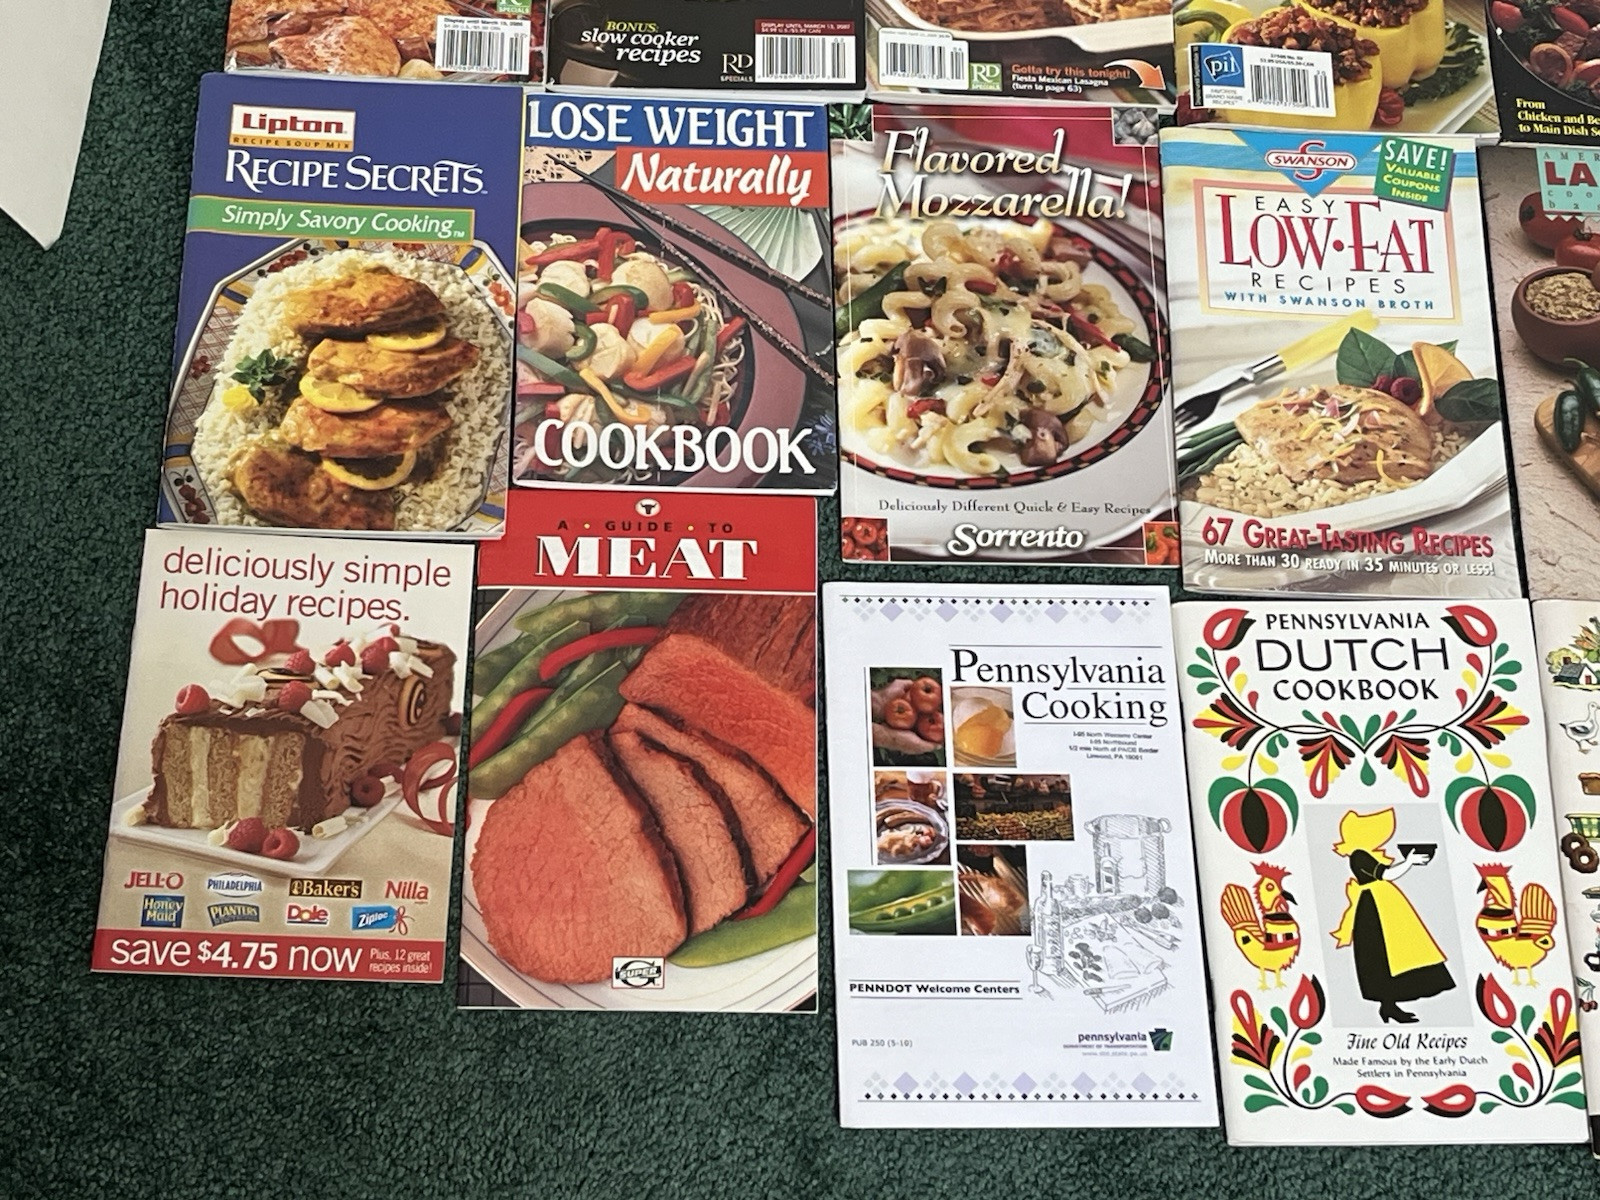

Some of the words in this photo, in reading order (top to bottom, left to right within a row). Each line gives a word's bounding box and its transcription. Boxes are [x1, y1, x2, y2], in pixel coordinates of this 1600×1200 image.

[606, 21, 659, 32] BONUS:
[581, 28, 627, 44] slow
[630, 31, 699, 48] cooker
[616, 47, 701, 66] recipes
[722, 53, 754, 74] RD
[1210, 56, 1236, 76] pil
[972, 63, 1000, 83] RD
[1012, 64, 1043, 74] Gotta
[1045, 65, 1062, 78] try
[1064, 67, 1085, 77] this
[1088, 67, 1131, 80] tonight!
[1012, 74, 1036, 83] Fiesta
[1038, 76, 1072, 84] Mexican
[1074, 77, 1109, 87] Lasagna
[1012, 82, 1033, 91] (turn
[1034, 83, 1043, 91] to
[1045, 84, 1065, 93] page
[1067, 84, 1082, 93] 63)
[1515, 98, 1546, 110] From
[242, 112, 344, 135] Lipton
[528, 100, 633, 143] LOSE
[643, 106, 815, 148] WEIGHT
[1517, 110, 1561, 123] Chicken
[1563, 114, 1584, 125] and
[1519, 124, 1531, 133] to
[1533, 123, 1561, 135] Main
[1563, 125, 1589, 136] Dish
[233, 137, 280, 146] RECIPE
[286, 140, 321, 148] SOUP
[878, 125, 1066, 175] Flavored
[1272, 154, 1349, 167] SWANSON
[1384, 139, 1448, 171] SAVE!
[225, 149, 340, 193] RECIPE
[345, 155, 484, 197] SECRETS
[620, 152, 813, 207] Naturally
[1385, 162, 1441, 182] VALUABLE
[873, 167, 1133, 219] Mozzarella!
[1383, 174, 1440, 194] COUPONS
[1391, 186, 1428, 203] INSIDE
[1255, 195, 1335, 215] EASY
[222, 205, 293, 230] Simply
[297, 209, 367, 234] Savory
[1252, 272, 1406, 294] RECIPES
[1224, 291, 1267, 303] WITH
[1279, 294, 1366, 308] SWANSON
[1378, 299, 1434, 310] BROTH
[534, 418, 816, 475] COOKBOOK
[878, 499, 948, 514] Deliciously
[952, 500, 1009, 513] Different
[1013, 501, 1054, 515] Quick
[1057, 502, 1067, 513] &
[1071, 502, 1100, 516] Easy
[1103, 503, 1152, 516] Recipes
[557, 520, 569, 530] A
[604, 520, 673, 533] GUIDE
[708, 522, 734, 533] TO
[947, 523, 1084, 557] Sorrento
[1201, 516, 1233, 546] 67
[1411, 526, 1495, 557] RECIPES
[535, 535, 758, 580] MEAT
[1204, 549, 1241, 566] MORE
[1245, 553, 1276, 568] THAN
[1280, 553, 1300, 568] 30
[1305, 558, 1342, 571] READY
[1346, 558, 1361, 572] IN
[1364, 557, 1384, 572] 35
[1389, 560, 1439, 574] MINUTES
[1442, 562, 1460, 575] OR
[1464, 562, 1495, 576] LESS!
[163, 546, 336, 588] deliciously
[343, 555, 451, 592] simple
[160, 581, 278, 621] holiday
[286, 589, 410, 626] recipes.
[1265, 612, 1430, 630] PENNSYLVANIA
[1255, 637, 1449, 672] DUTCH
[950, 648, 1166, 692] Pennsylvania
[1273, 678, 1439, 701] COOKBOOK
[1021, 691, 1168, 728] Cooking
[207, 878, 263, 892] PHILADELPHIA
[302, 880, 360, 898] Baker's
[385, 880, 429, 900] Nilla
[143, 897, 183, 911] Honey
[210, 906, 258, 919] PLANTERS
[287, 904, 329, 920] Dole
[146, 910, 177, 922] Maid
[358, 911, 389, 928] Ziploc
[110, 938, 192, 966] save
[197, 940, 279, 970] $4.75
[288, 945, 363, 973] now
[395, 949, 406, 961] 12
[407, 951, 431, 963] great
[368, 963, 401, 975] recipes
[402, 963, 432, 974] inside!
[620, 966, 658, 979] SUPER
[849, 983, 912, 993] PENNDOT
[916, 984, 971, 994] Welcome
[974, 984, 1020, 994] Centers
[851, 1039, 868, 1047] PUB
[870, 1039, 886, 1047] 250
[1078, 1031, 1147, 1044] pennsylvania
[1346, 1033, 1378, 1050] Fine
[1382, 1032, 1411, 1050] Old
[1416, 1032, 1468, 1053] Recipes
[1332, 1056, 1359, 1066] Made
[1361, 1056, 1397, 1066] Famous
[1400, 1056, 1412, 1067] by
[1415, 1056, 1430, 1065] the
[1433, 1056, 1456, 1066] Early
[1459, 1056, 1488, 1064] Dutch
[1357, 1069, 1391, 1078] Settlers
[1394, 1070, 1404, 1078] in
[1406, 1069, 1467, 1079] Pennsylvania
